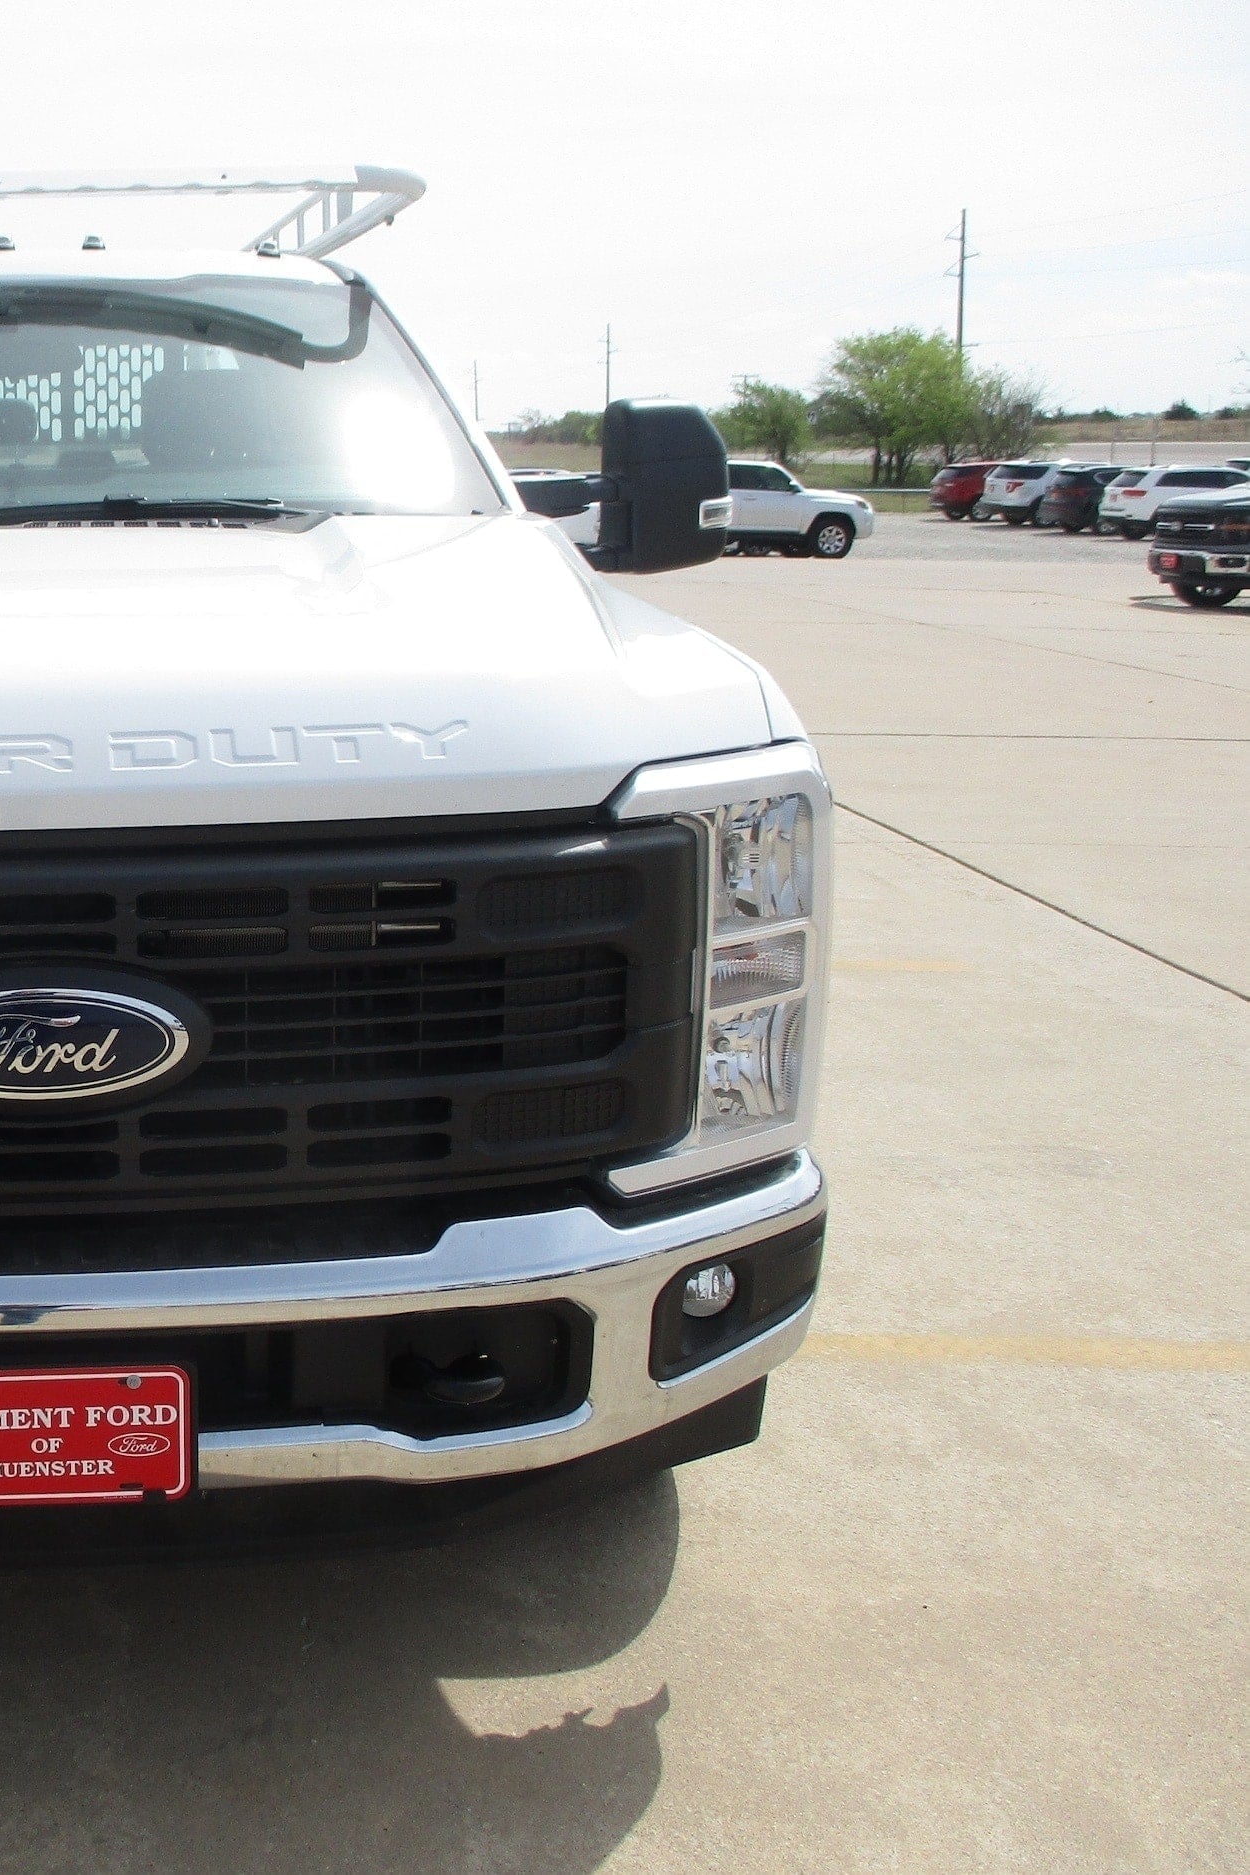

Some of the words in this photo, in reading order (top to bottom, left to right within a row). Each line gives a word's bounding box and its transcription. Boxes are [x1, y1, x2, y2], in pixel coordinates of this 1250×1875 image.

[108, 719, 470, 771] DUTY
[85, 1405, 179, 1427] FORD
[31, 1437, 64, 1454] OF
[118, 1436, 158, 1454] Ford
